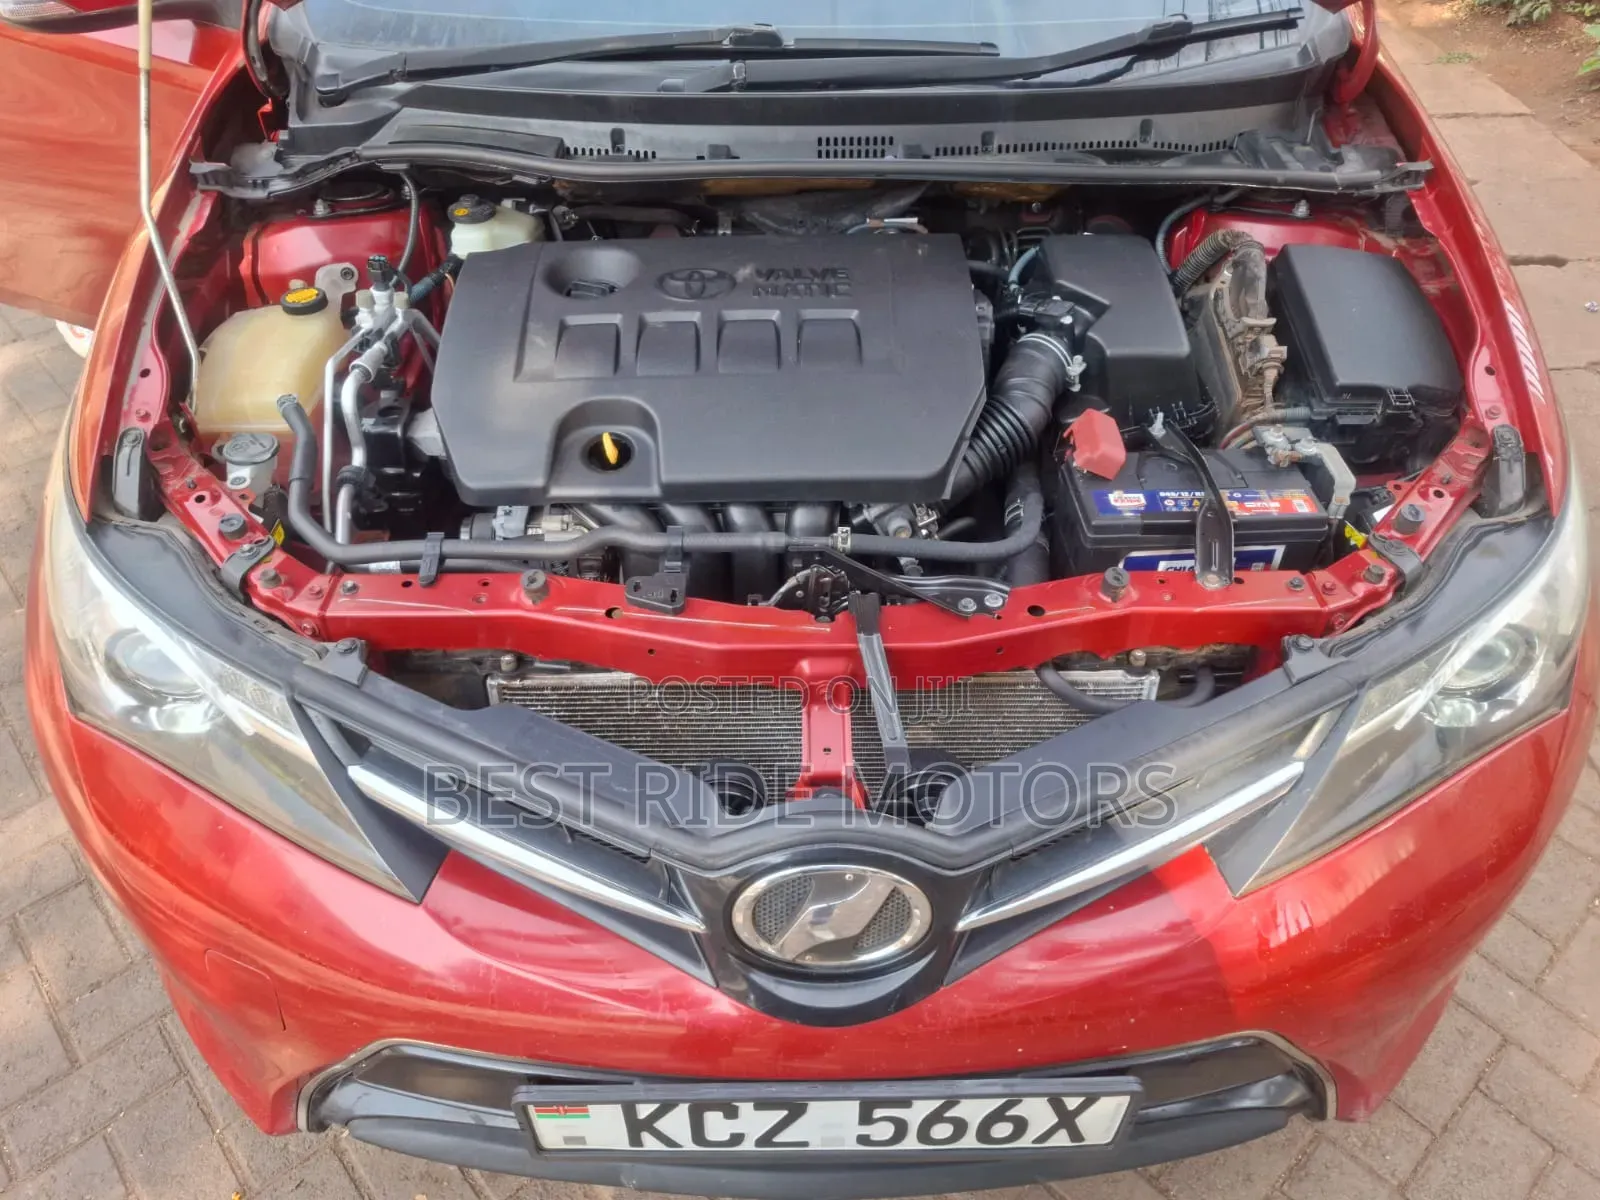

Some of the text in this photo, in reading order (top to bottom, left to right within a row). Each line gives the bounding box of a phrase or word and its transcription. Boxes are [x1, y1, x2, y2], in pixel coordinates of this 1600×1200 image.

[755, 267, 850, 281] VALVE
[752, 282, 852, 298] MATIC
[620, 1097, 1101, 1148] KCZ 566X
